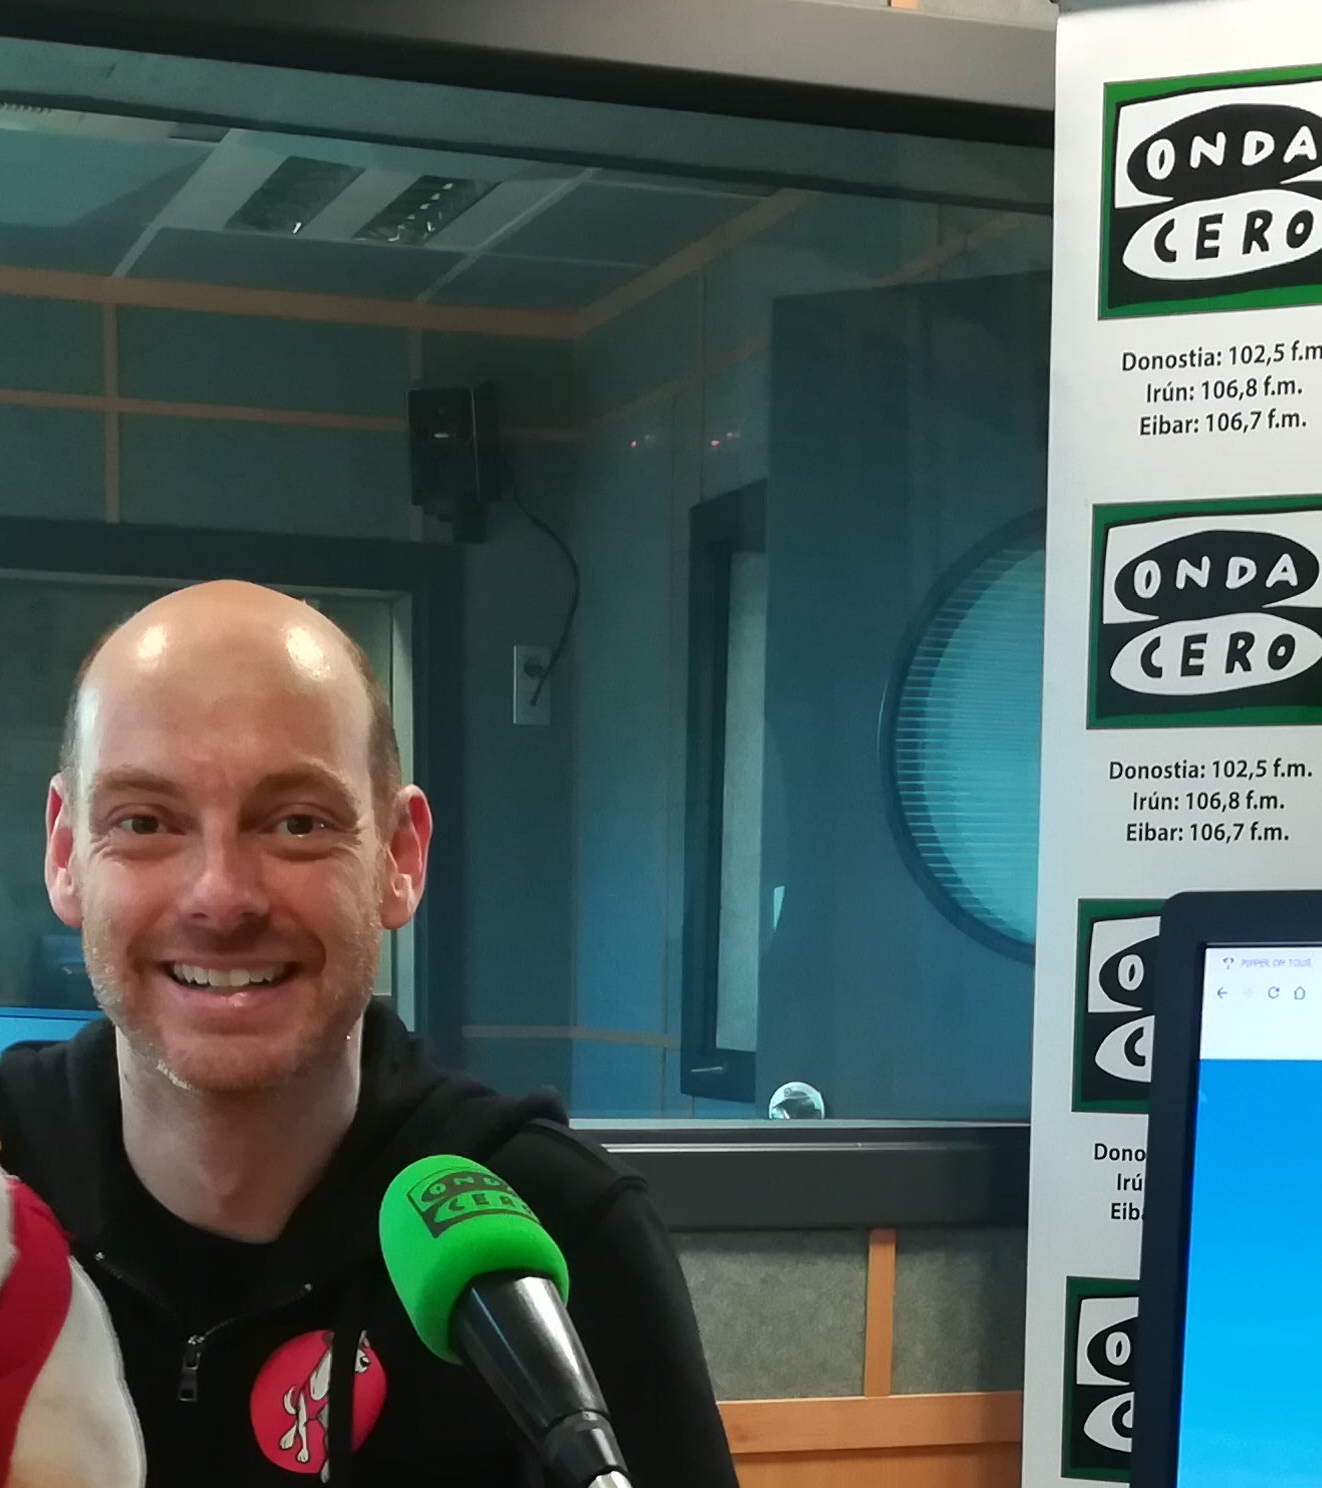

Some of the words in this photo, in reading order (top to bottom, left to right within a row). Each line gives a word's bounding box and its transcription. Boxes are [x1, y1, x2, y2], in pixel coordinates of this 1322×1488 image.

[1147, 126, 1317, 180] ONDA
[1155, 210, 1313, 262] CERO
[1121, 346, 1222, 372] Donostia:
[1229, 342, 1285, 367] 102,5
[1146, 380, 1195, 403] Irún:
[1201, 377, 1258, 401] 106,8
[1263, 374, 1303, 397] f.m.
[1139, 414, 1199, 436] Eibar:
[1205, 410, 1262, 434] 106,7
[1267, 407, 1307, 430] f.m.
[1134, 554, 1297, 598] ONDA
[1141, 632, 1295, 678] CERO
[1109, 759, 1206, 780] Donostia:
[1212, 759, 1268, 781] 102,5
[1272, 757, 1313, 778] f.m.
[1133, 791, 1180, 811] Irún:
[1185, 791, 1240, 813] 106,8
[1245, 789, 1285, 810] f.m.
[1126, 821, 1184, 842] Eibar:
[1190, 822, 1245, 844] 106,7
[1250, 820, 1290, 841] f.m.
[1117, 1173, 1143, 1191] Irú
[1111, 1202, 1140, 1221] Eib
